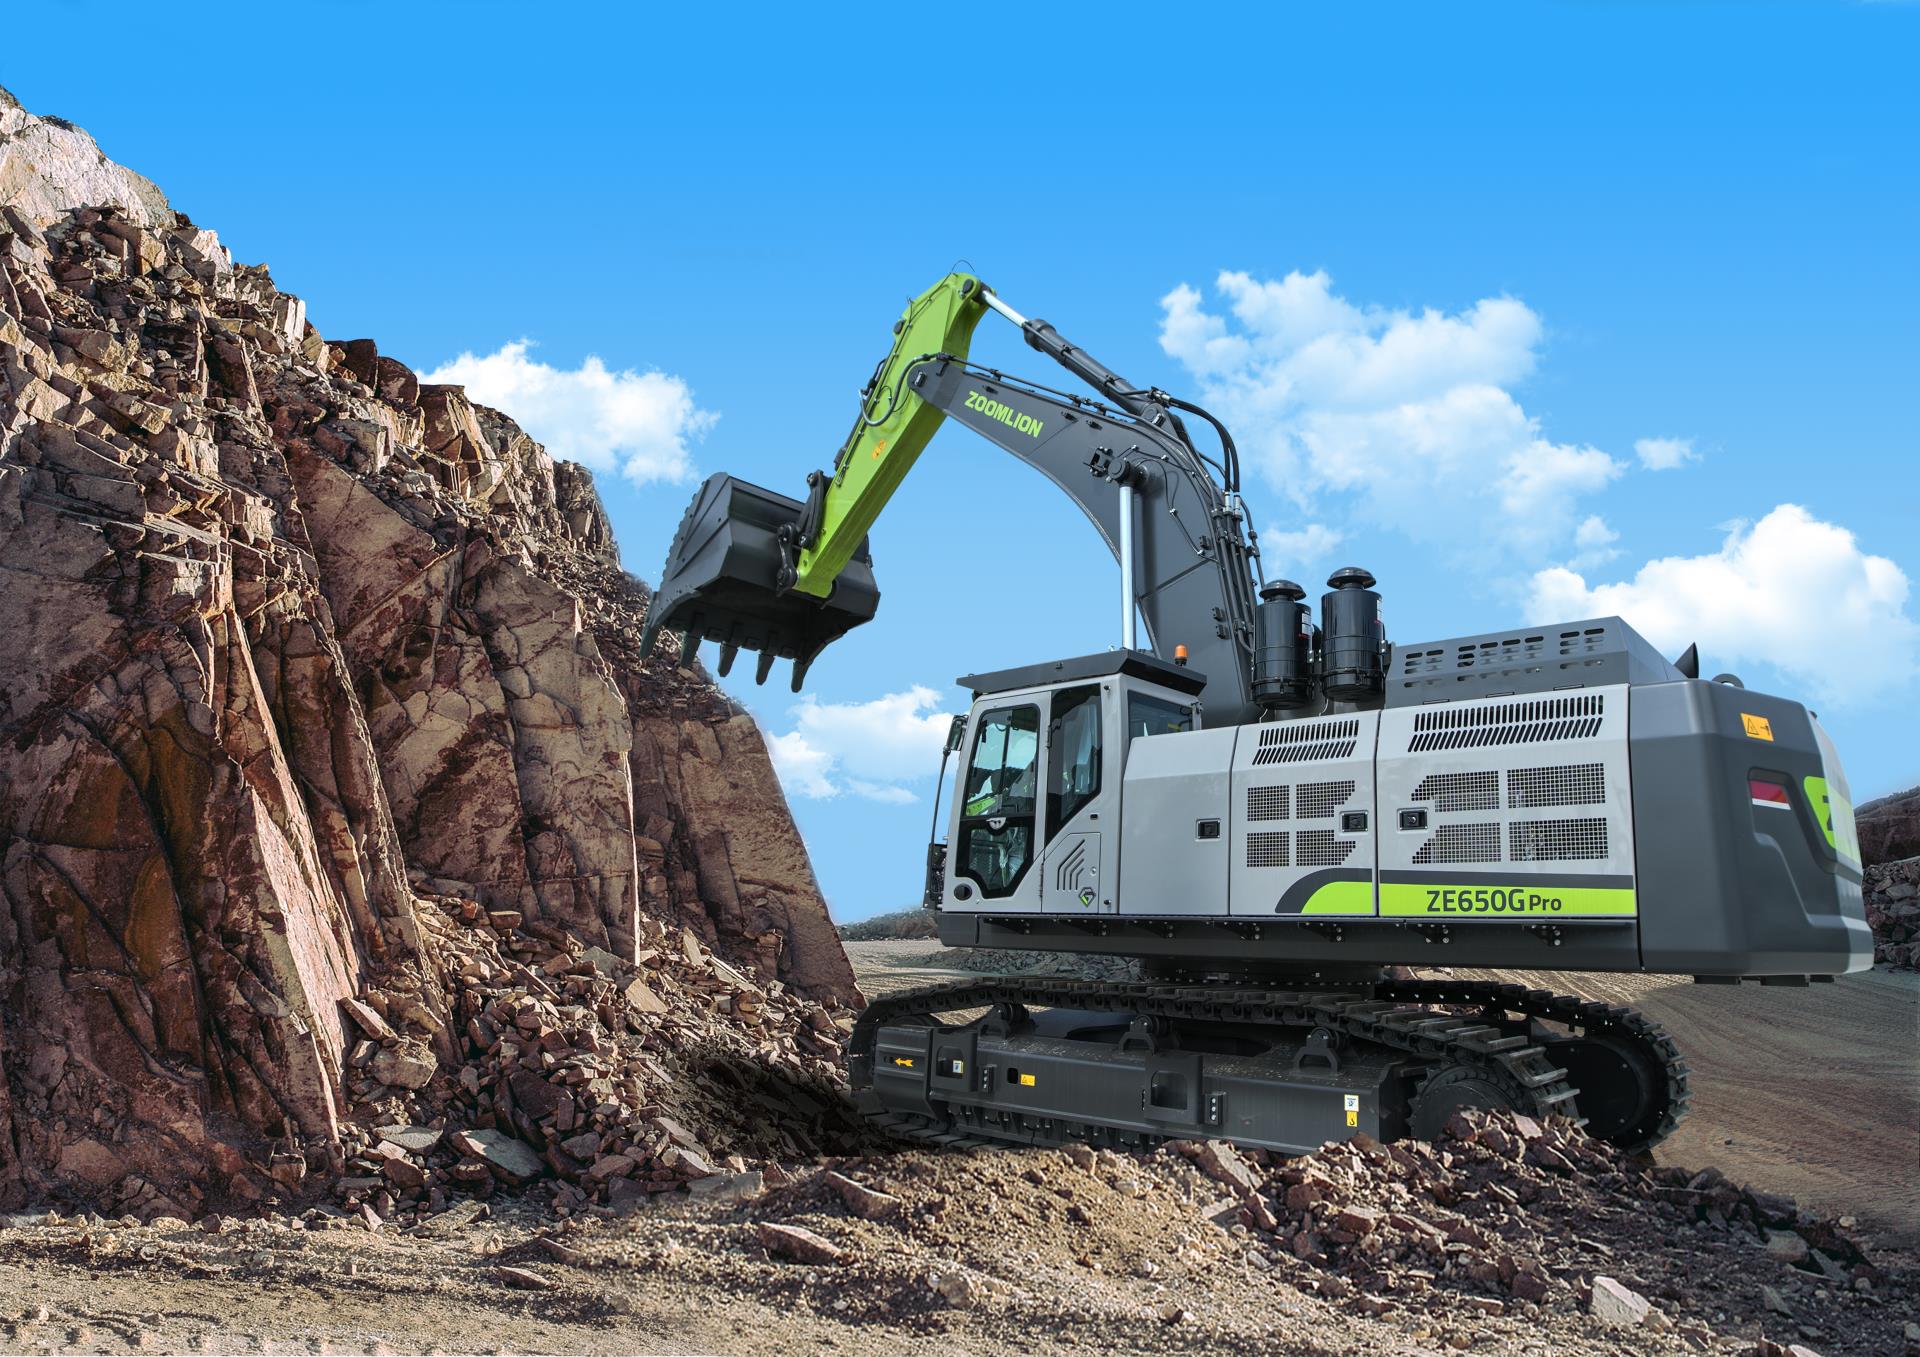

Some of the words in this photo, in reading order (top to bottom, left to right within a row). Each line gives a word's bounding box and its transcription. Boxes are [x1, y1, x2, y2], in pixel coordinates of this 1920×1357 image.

[964, 390, 1044, 438] ZOOMLION
[1426, 889, 1525, 912] ZE650G
[1529, 894, 1562, 911] Pro
